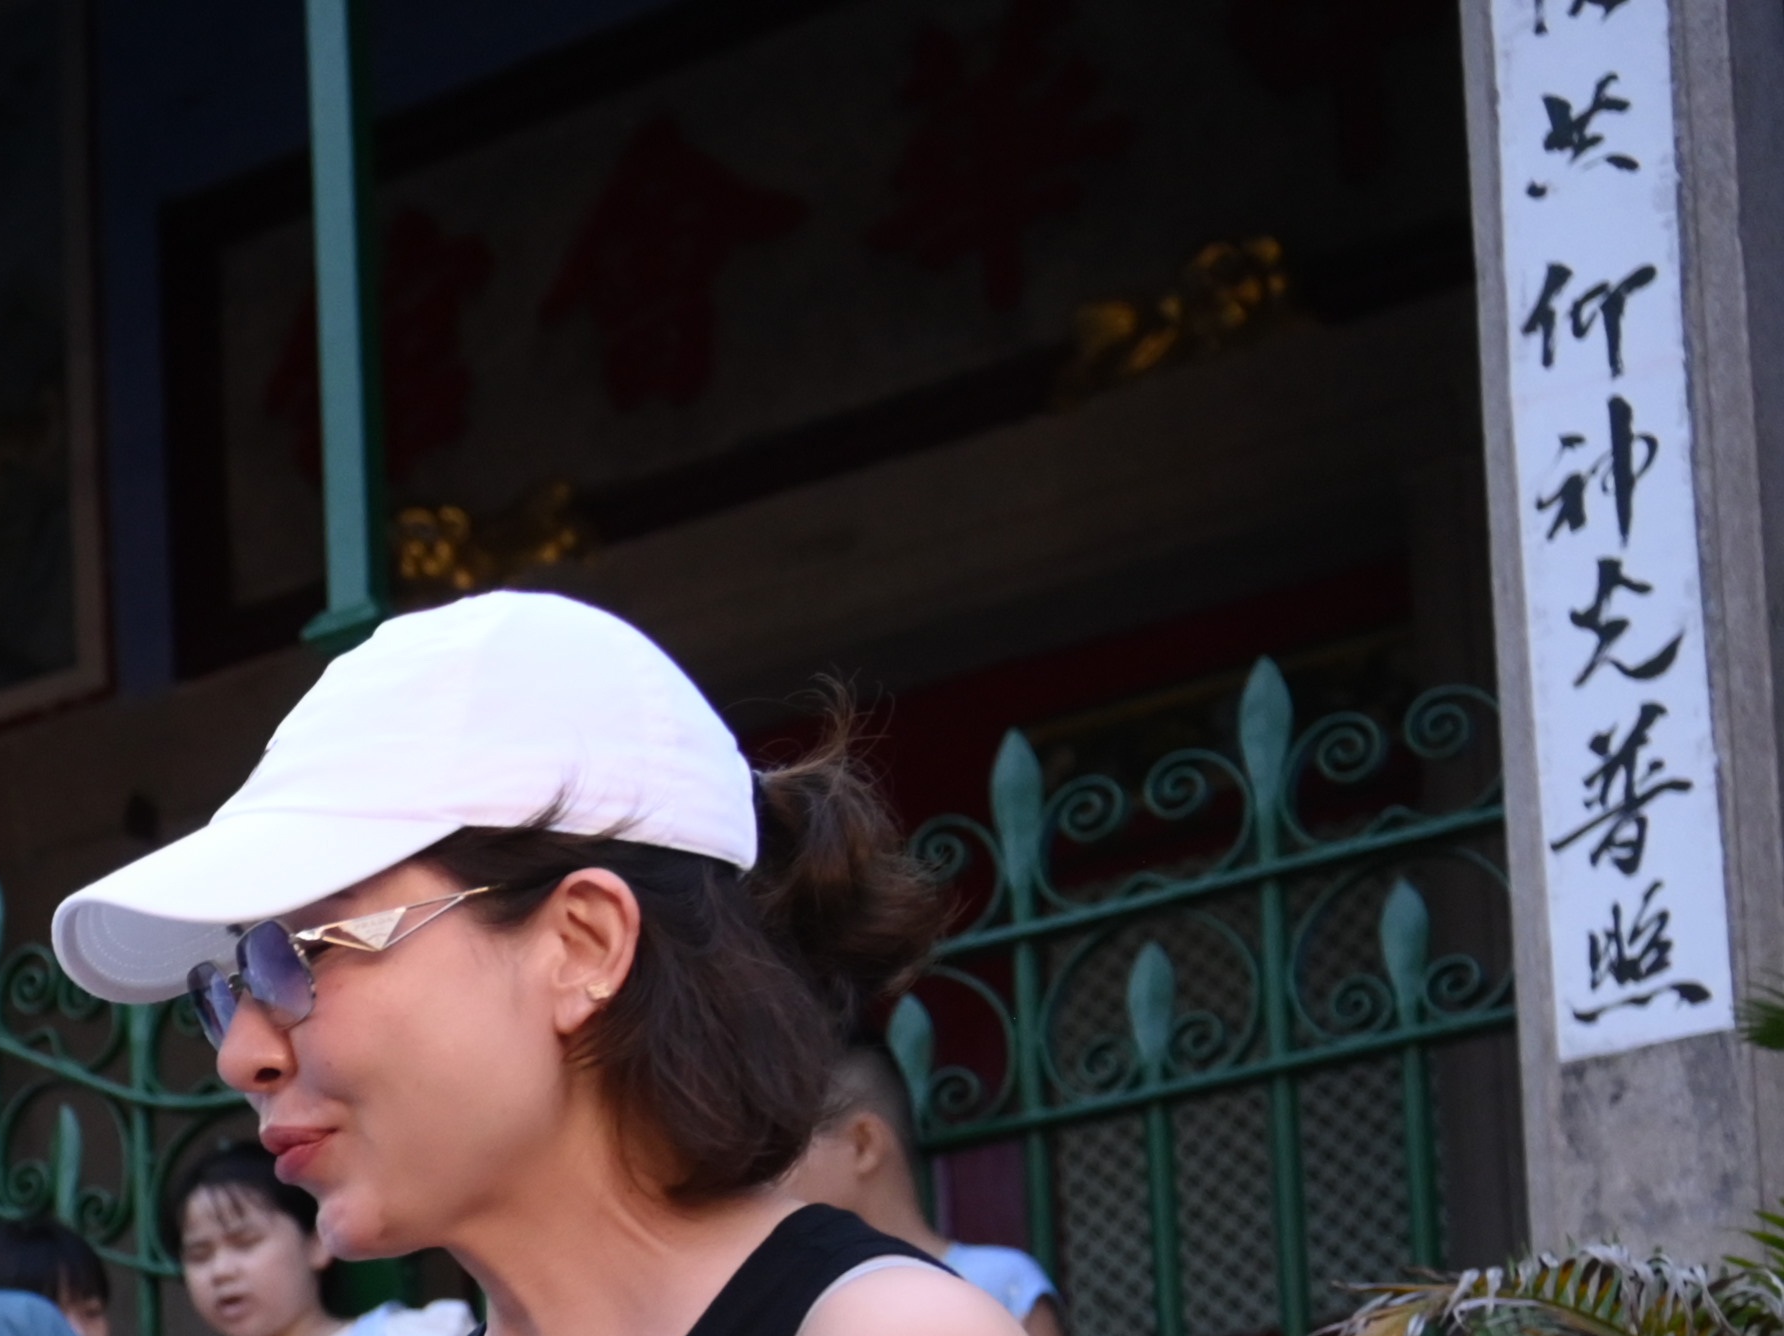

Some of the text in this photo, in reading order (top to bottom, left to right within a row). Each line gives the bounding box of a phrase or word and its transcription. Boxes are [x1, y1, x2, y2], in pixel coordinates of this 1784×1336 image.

[1521, 0, 1712, 1024] 共仰神光普照
